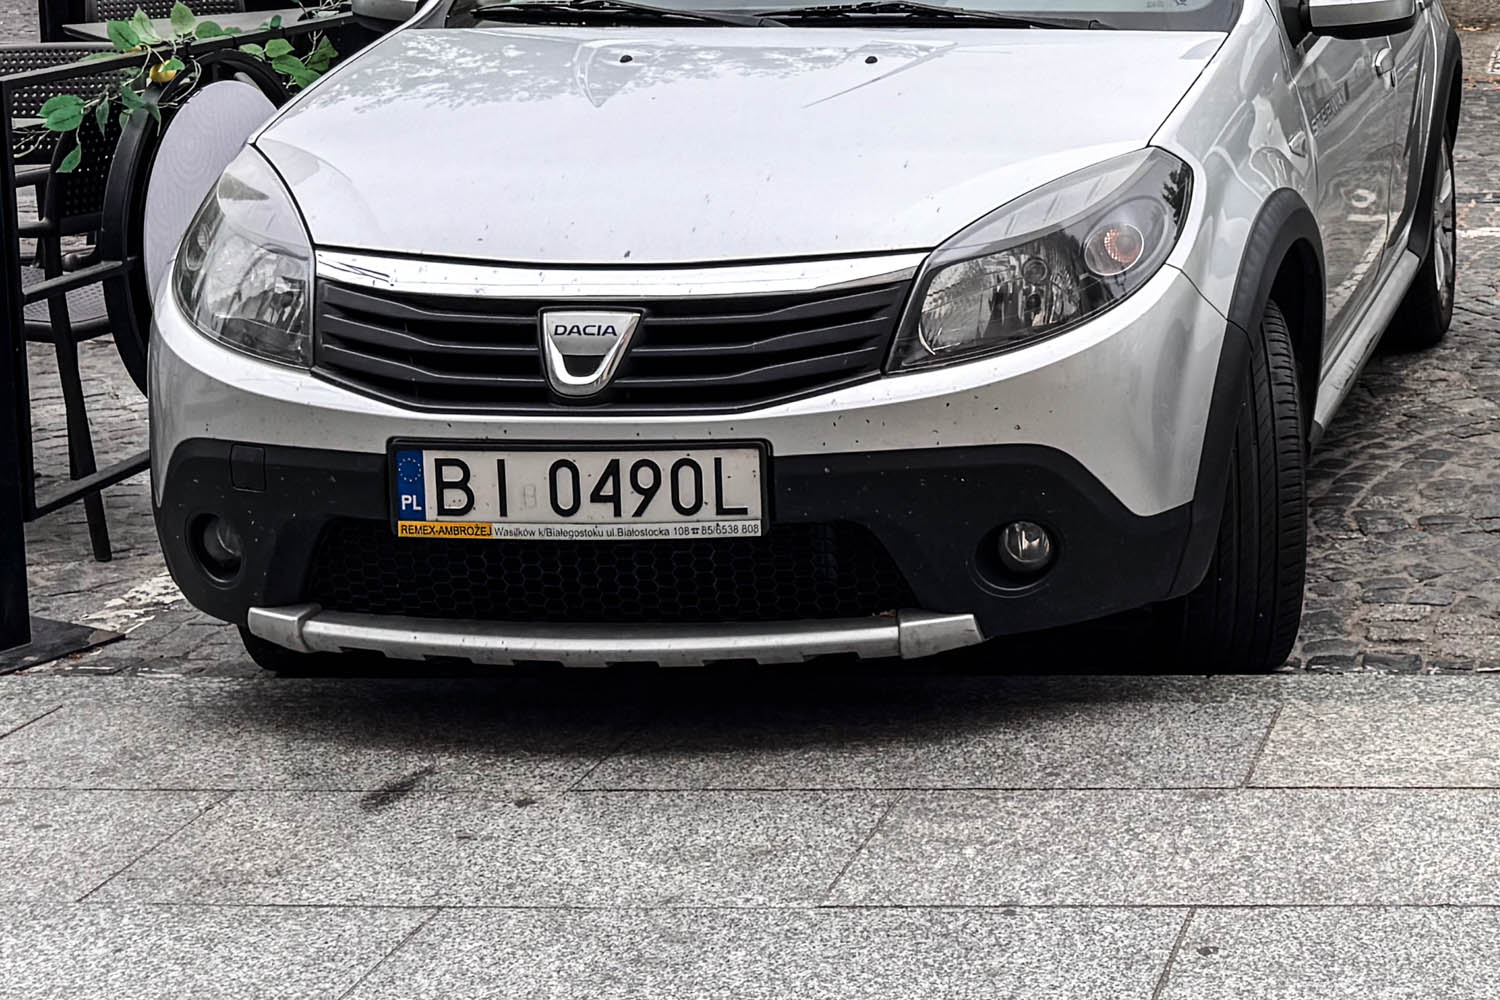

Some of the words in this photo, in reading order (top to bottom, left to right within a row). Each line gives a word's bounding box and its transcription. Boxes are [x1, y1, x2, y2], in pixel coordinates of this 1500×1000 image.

[554, 325, 617, 336] DACIA
[434, 457, 508, 518] BI
[548, 457, 749, 518] 0490L
[401, 495, 422, 512] PL
[400, 523, 493, 537] REMEX-AMBROŻEJ
[673, 526, 690, 537] 108
[741, 523, 760, 534] 808
